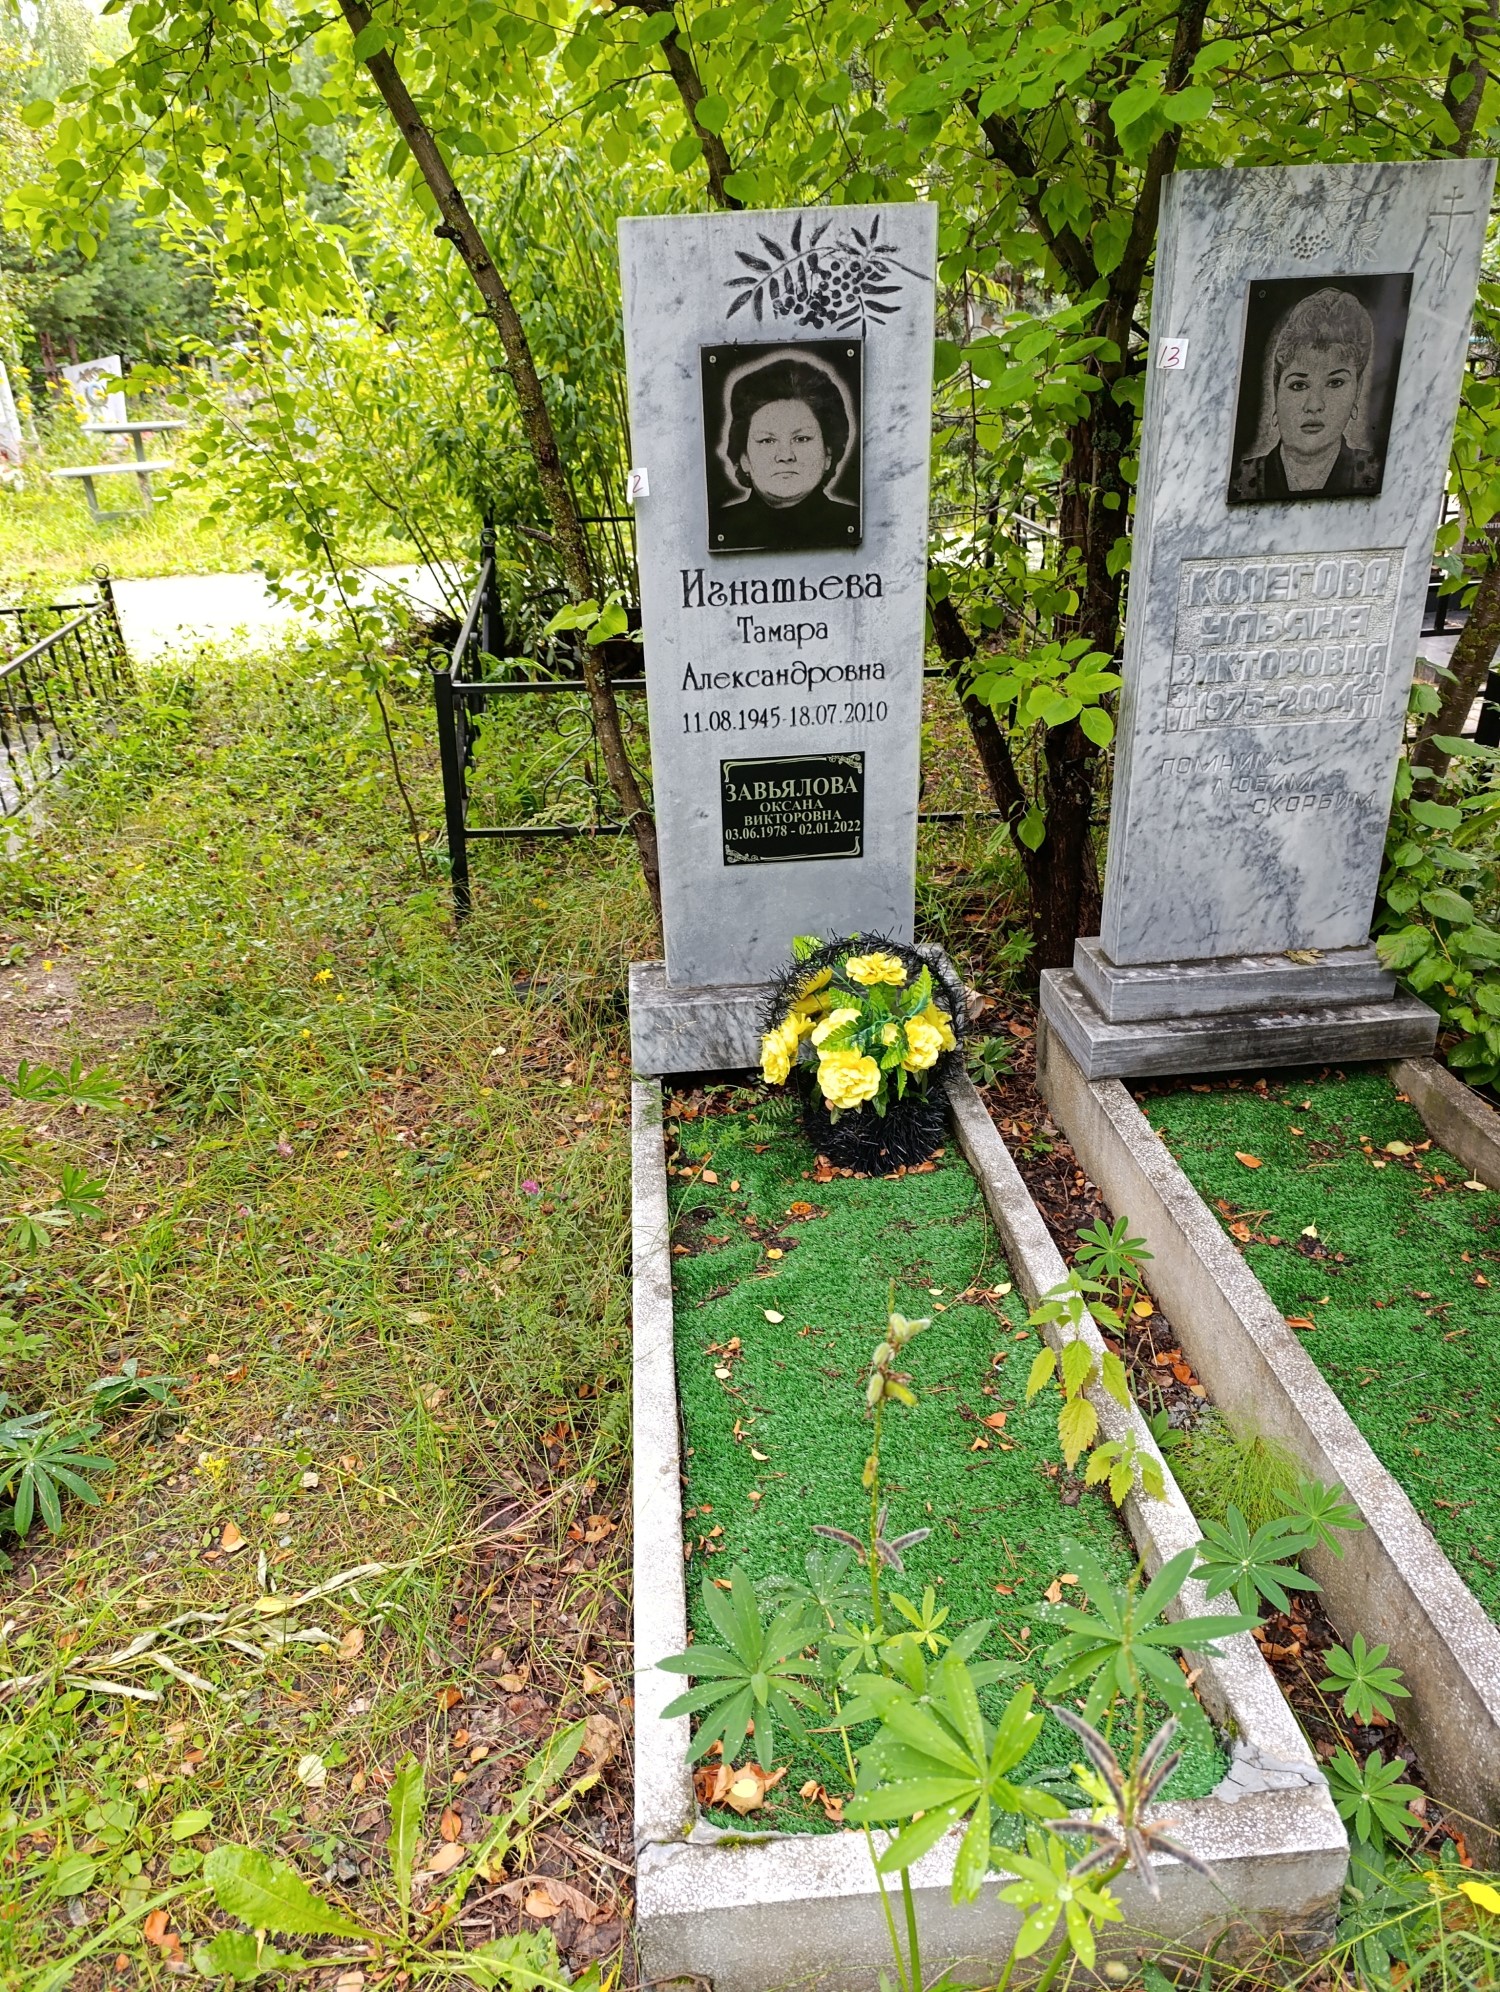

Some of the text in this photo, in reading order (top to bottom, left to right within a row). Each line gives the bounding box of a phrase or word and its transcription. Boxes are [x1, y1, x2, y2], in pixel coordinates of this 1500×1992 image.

[1158, 345, 1180, 369] 13
[680, 568, 883, 608] Игнатьева
[1188, 557, 1391, 607] КОЛЕГОВА
[737, 615, 829, 649] Тамара
[1199, 605, 1371, 646] УЛЬЯНА
[681, 660, 885, 692] Александровна
[1170, 642, 1388, 685] ВИКТОРОВНА
[1161, 751, 1280, 775] ПОМНИМ
[725, 775, 858, 802] ЗАВЬЯЛОВА
[1212, 772, 1315, 795] ЛЮБИМ
[759, 799, 824, 813] ОКСАНА
[1252, 789, 1378, 814] СКОРБИМ
[725, 825, 788, 840] 03.06.1978
[799, 819, 861, 835] 02.01.2022
[744, 810, 842, 826] ВИКТОРОВНА
